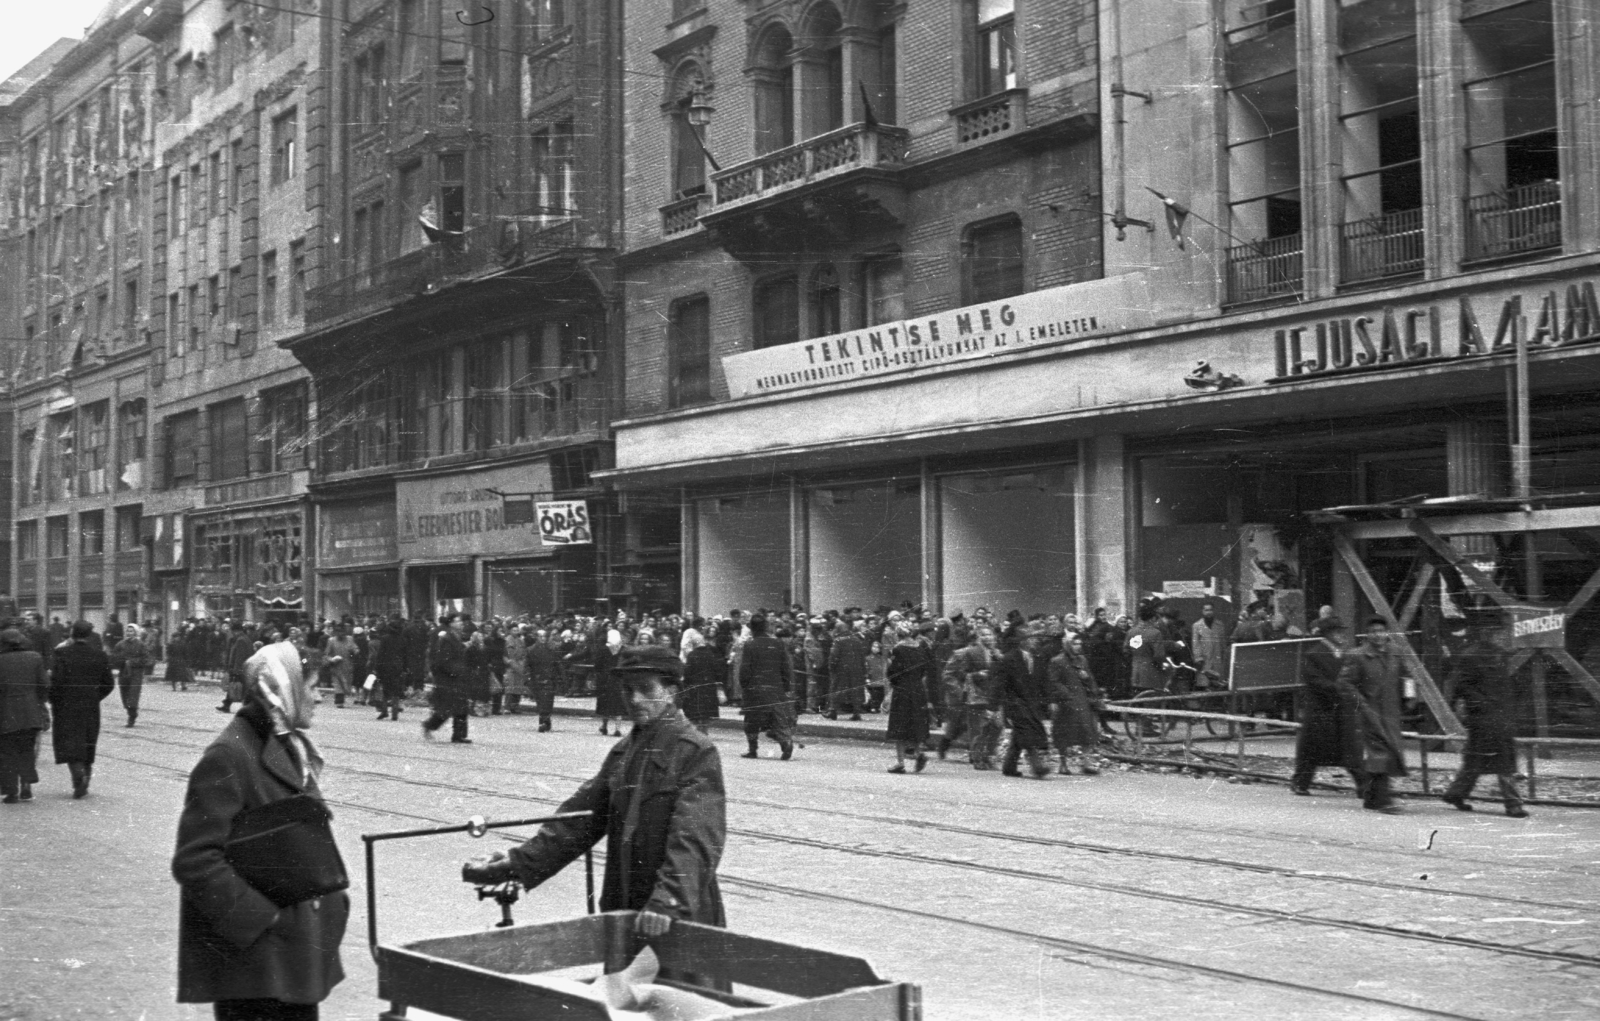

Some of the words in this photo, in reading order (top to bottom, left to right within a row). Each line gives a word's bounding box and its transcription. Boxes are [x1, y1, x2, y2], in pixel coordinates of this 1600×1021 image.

[804, 320, 940, 364] TEKINTSE
[957, 304, 1015, 335] MEG
[994, 333, 1007, 347] AZ
